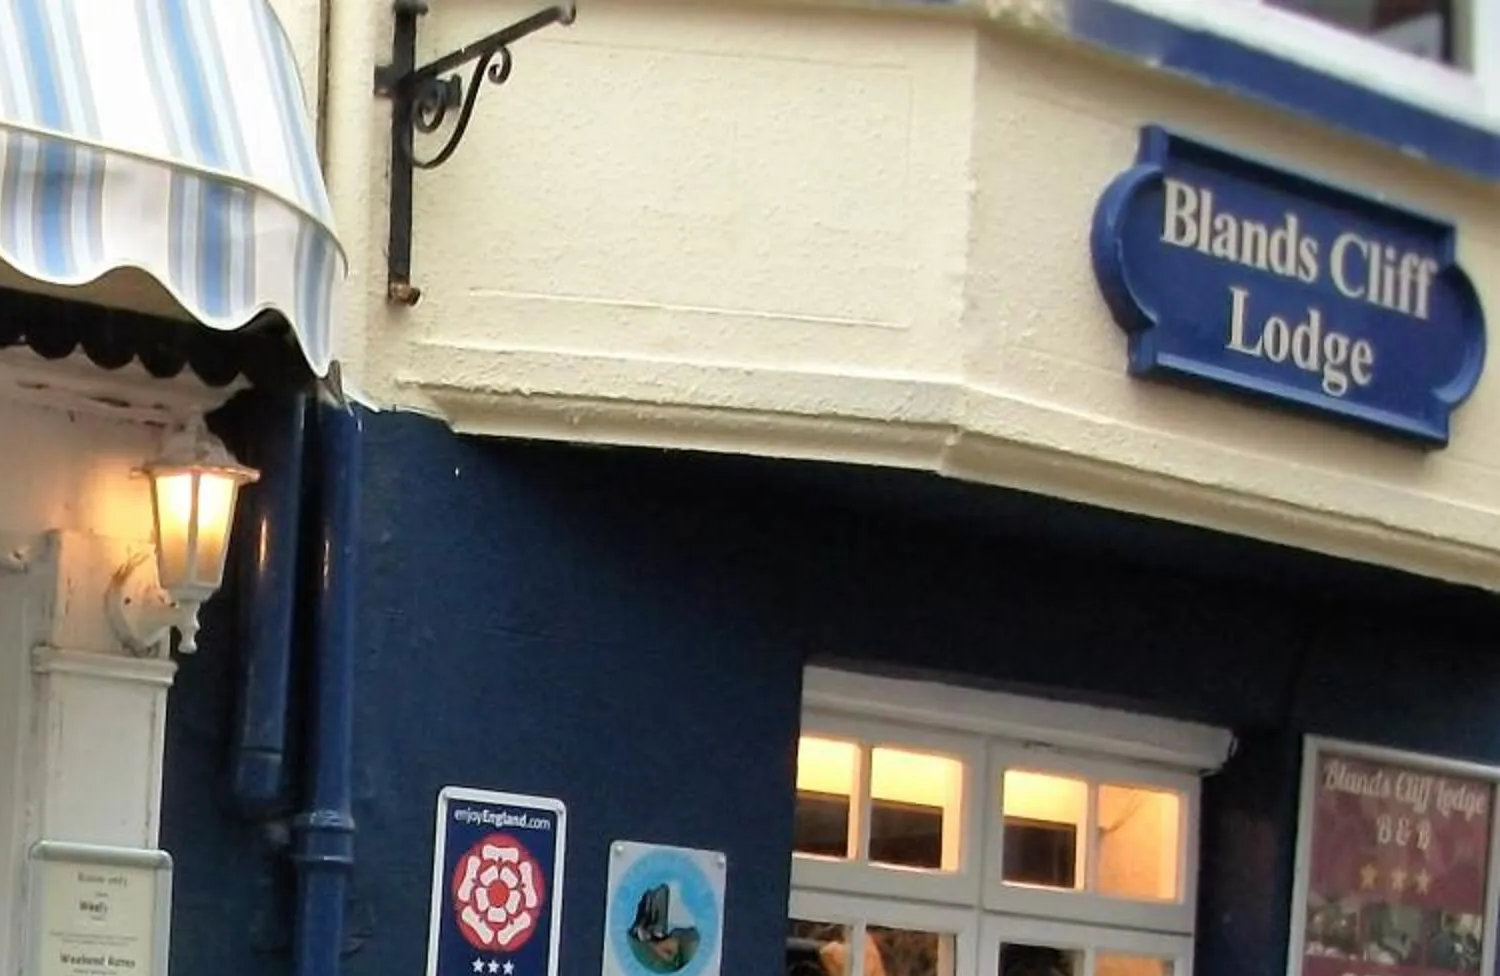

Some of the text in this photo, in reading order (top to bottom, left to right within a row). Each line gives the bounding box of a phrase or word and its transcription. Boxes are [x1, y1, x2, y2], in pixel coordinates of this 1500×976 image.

[1160, 180, 1438, 319] Blands Cliff
[1226, 286, 1373, 397] Lodge
[454, 808, 551, 831] enjoyEngland.com
[1323, 759, 1391, 796] Blands
[1395, 770, 1433, 814] Cliff
